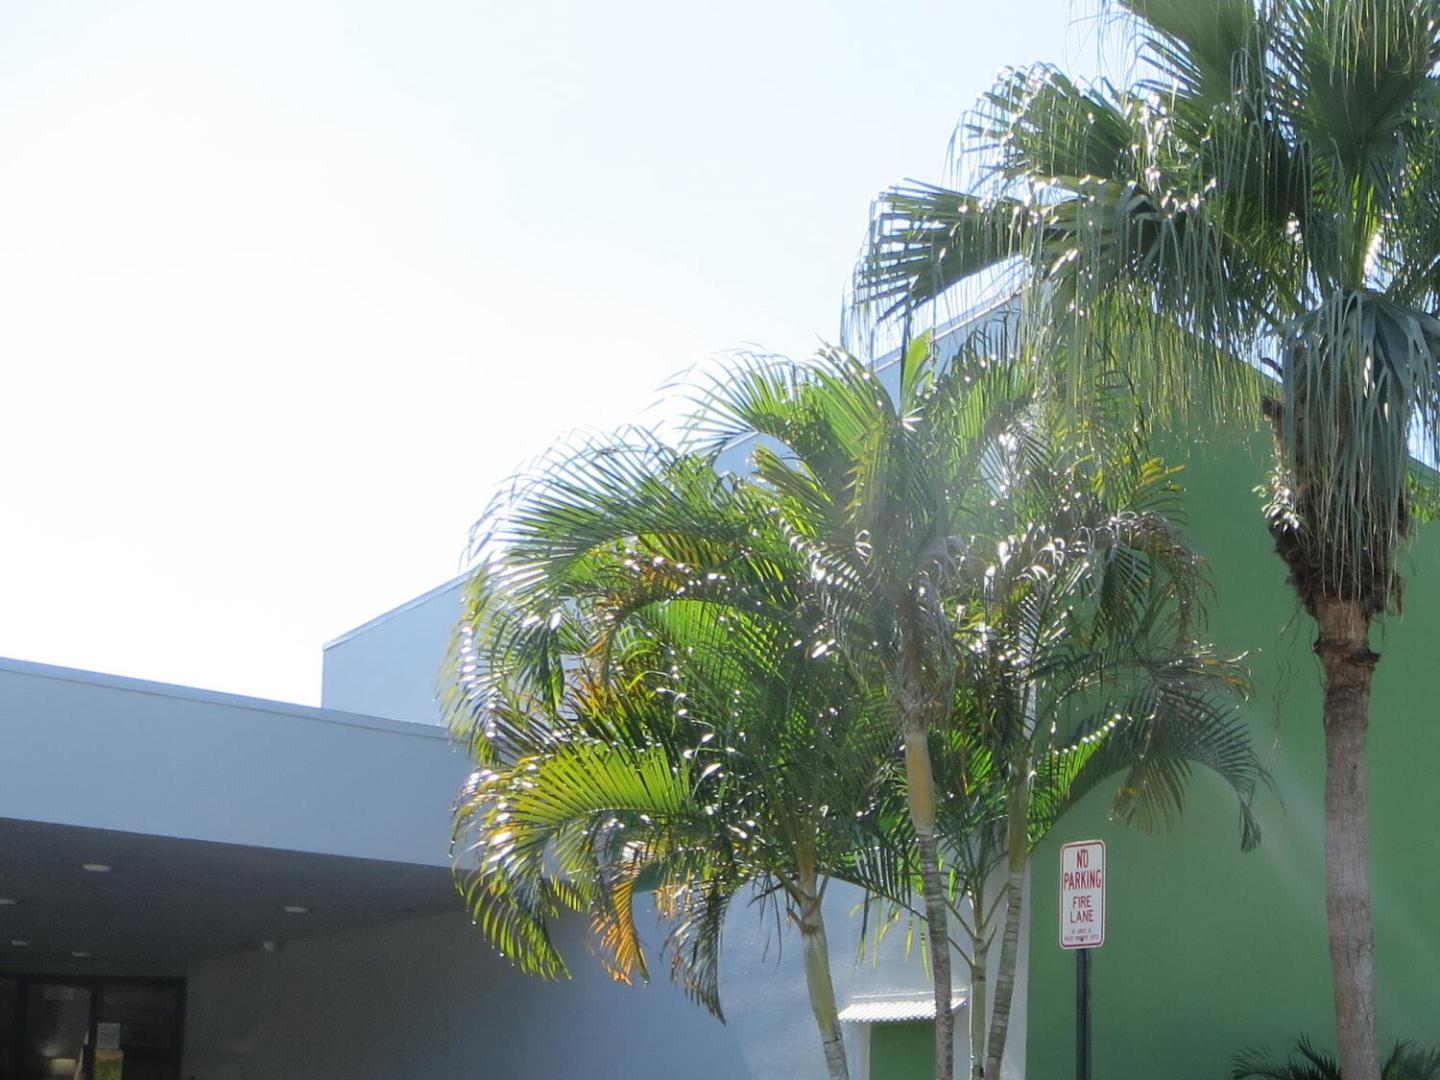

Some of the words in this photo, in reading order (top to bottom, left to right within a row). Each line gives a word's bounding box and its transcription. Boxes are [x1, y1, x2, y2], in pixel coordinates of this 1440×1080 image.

[1076, 849, 1089, 868] NO
[1064, 869, 1101, 890] PARKING
[1073, 895, 1092, 909] FIRE
[1070, 909, 1094, 923] LANE
